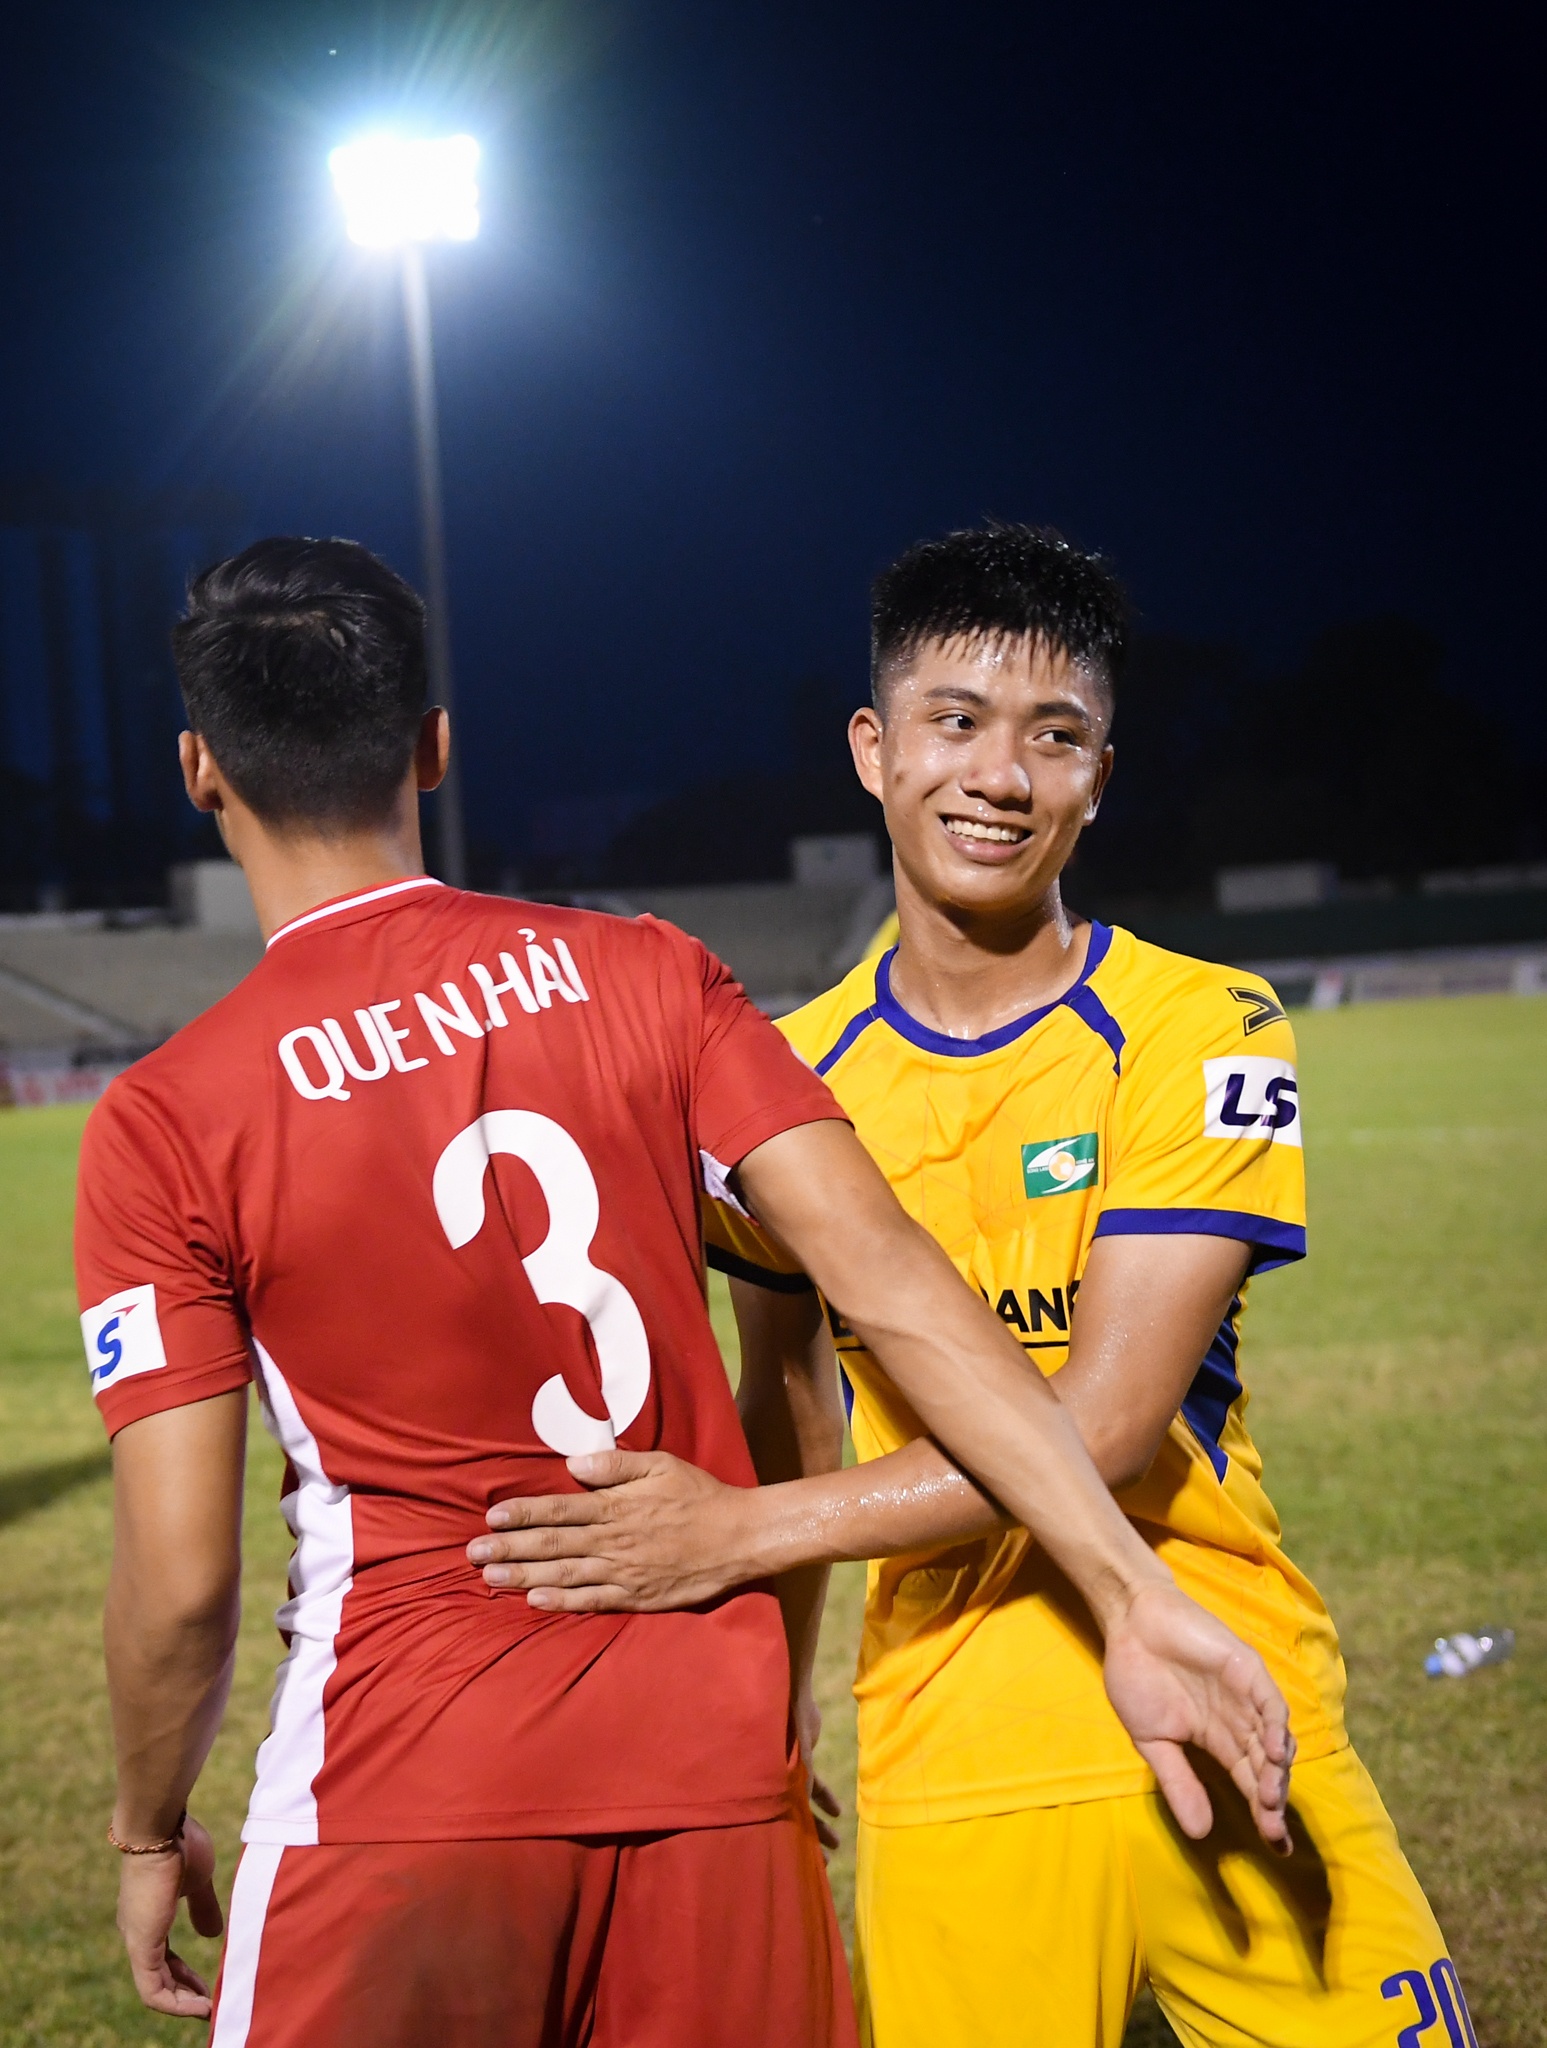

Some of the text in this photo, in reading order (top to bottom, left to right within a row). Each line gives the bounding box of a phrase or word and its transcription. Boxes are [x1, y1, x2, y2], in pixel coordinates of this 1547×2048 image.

[1220, 1073, 1298, 1129] LS
[432, 1109, 651, 1457] 3
[980, 1281, 1080, 1333] AN
[91, 1316, 122, 1382] S
[1380, 1958, 1478, 2048] 20
